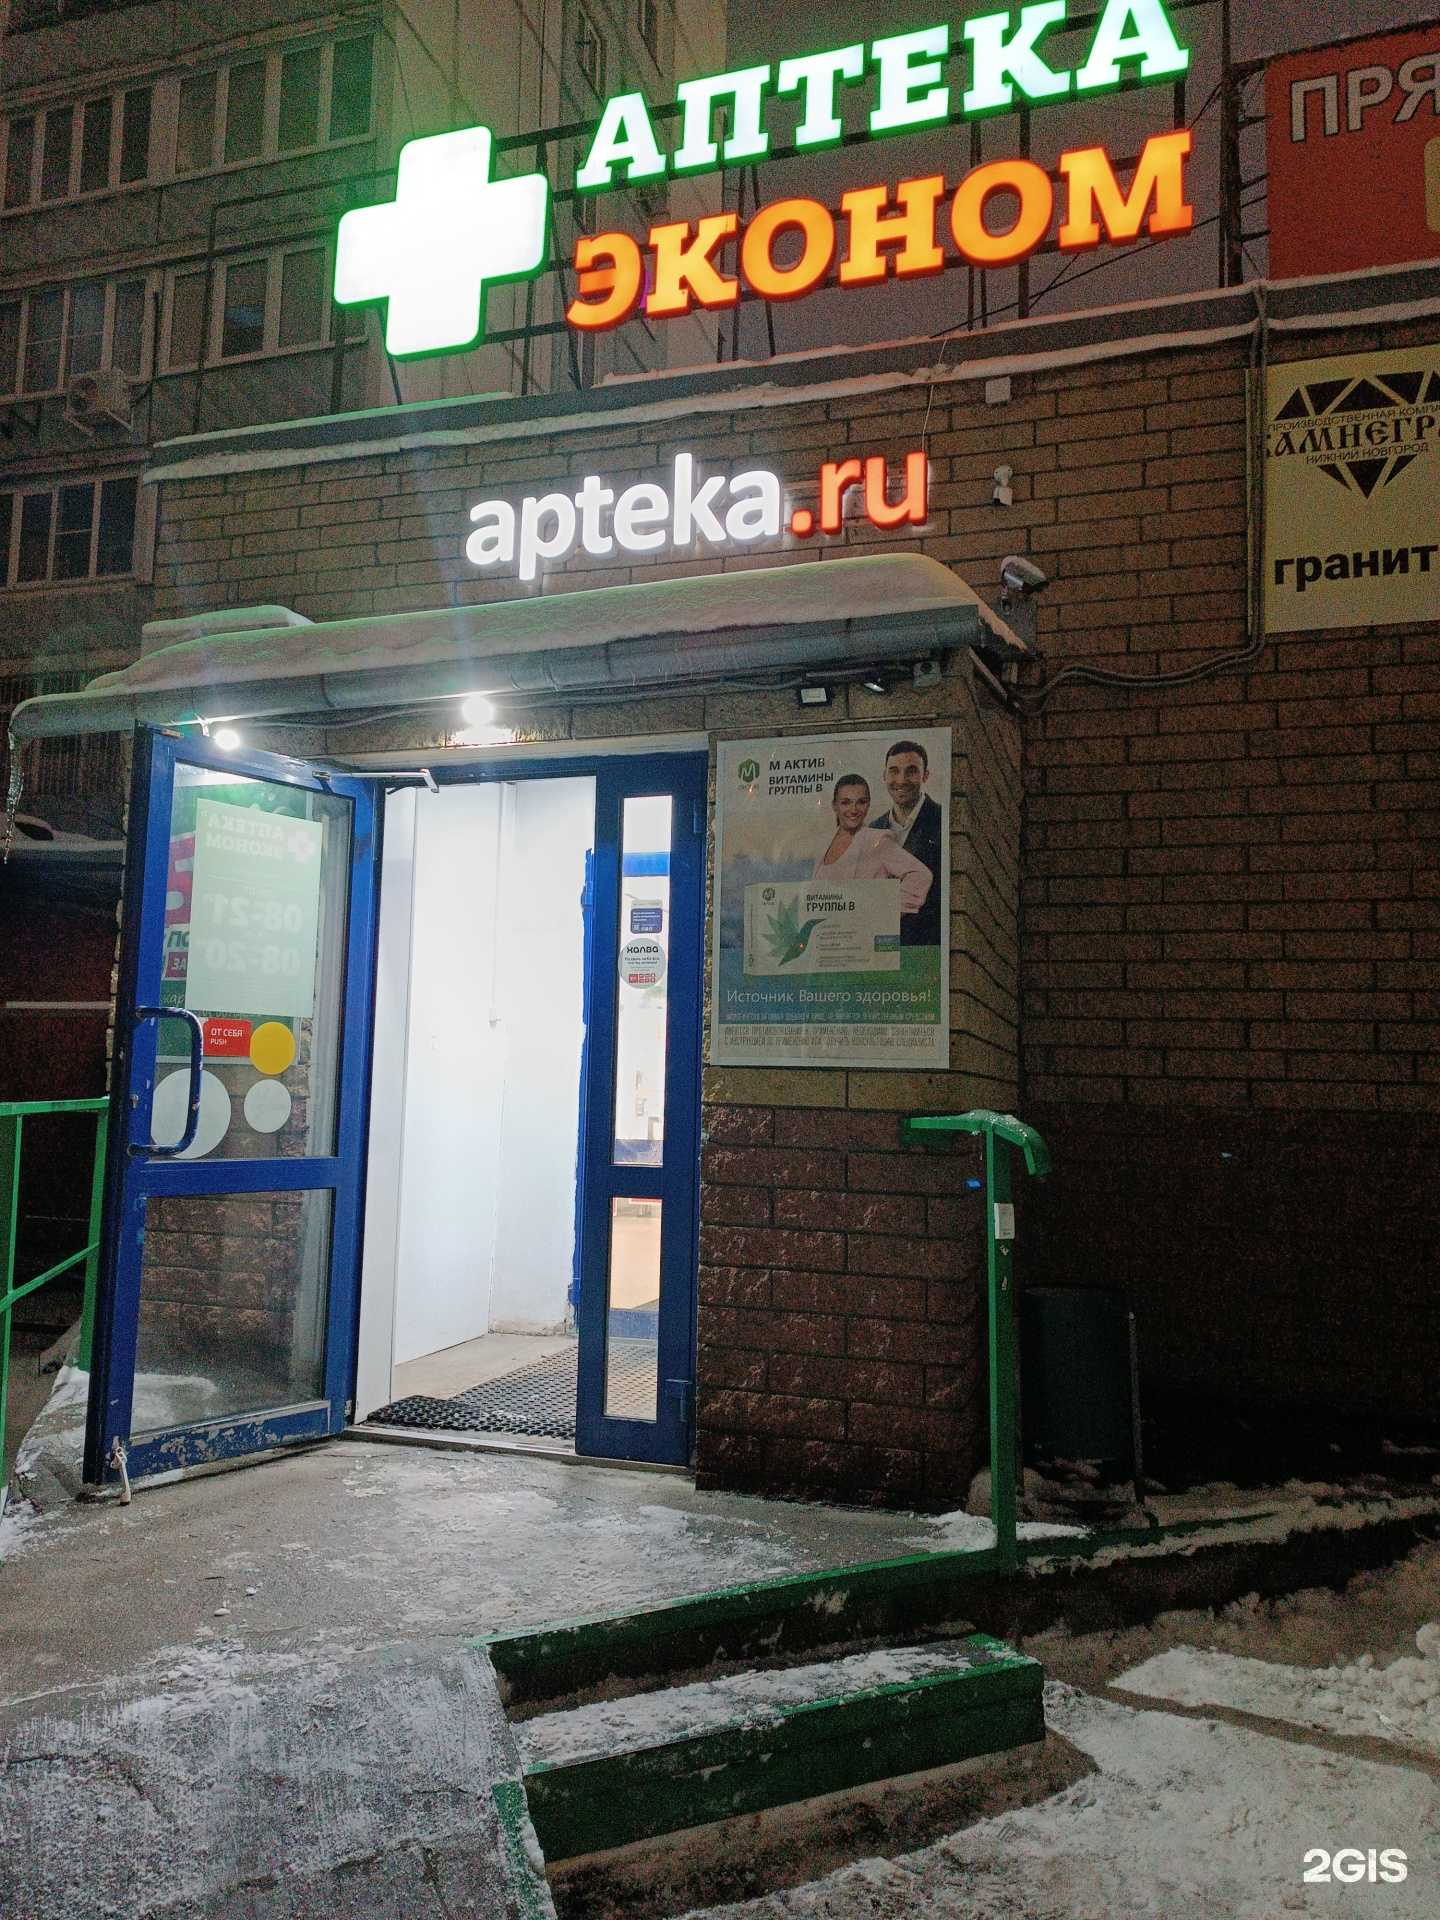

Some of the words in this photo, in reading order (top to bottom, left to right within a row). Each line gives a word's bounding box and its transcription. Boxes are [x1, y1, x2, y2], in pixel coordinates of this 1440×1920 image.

[575, 0, 1191, 189] АПТЕКА
[566, 130, 1194, 330] ЭКОНОМ
[1268, 408, 1398, 433] ПРОИЗВОДСТВЕННАЯ
[1362, 442, 1429, 457] НОВГОРОД
[465, 451, 927, 581] apteka.ru
[1275, 544, 1439, 592] гранит
[768, 773, 834, 785] ВИТАМИНЫ
[768, 784, 813, 795] ГРУППЫ
[806, 901, 846, 912] ГРУППЫ
[727, 989, 794, 1003] Источник
[799, 989, 851, 1003] Вашего
[856, 988, 932, 1004] здоровья!
[210, 1027, 222, 1037] ОТ
